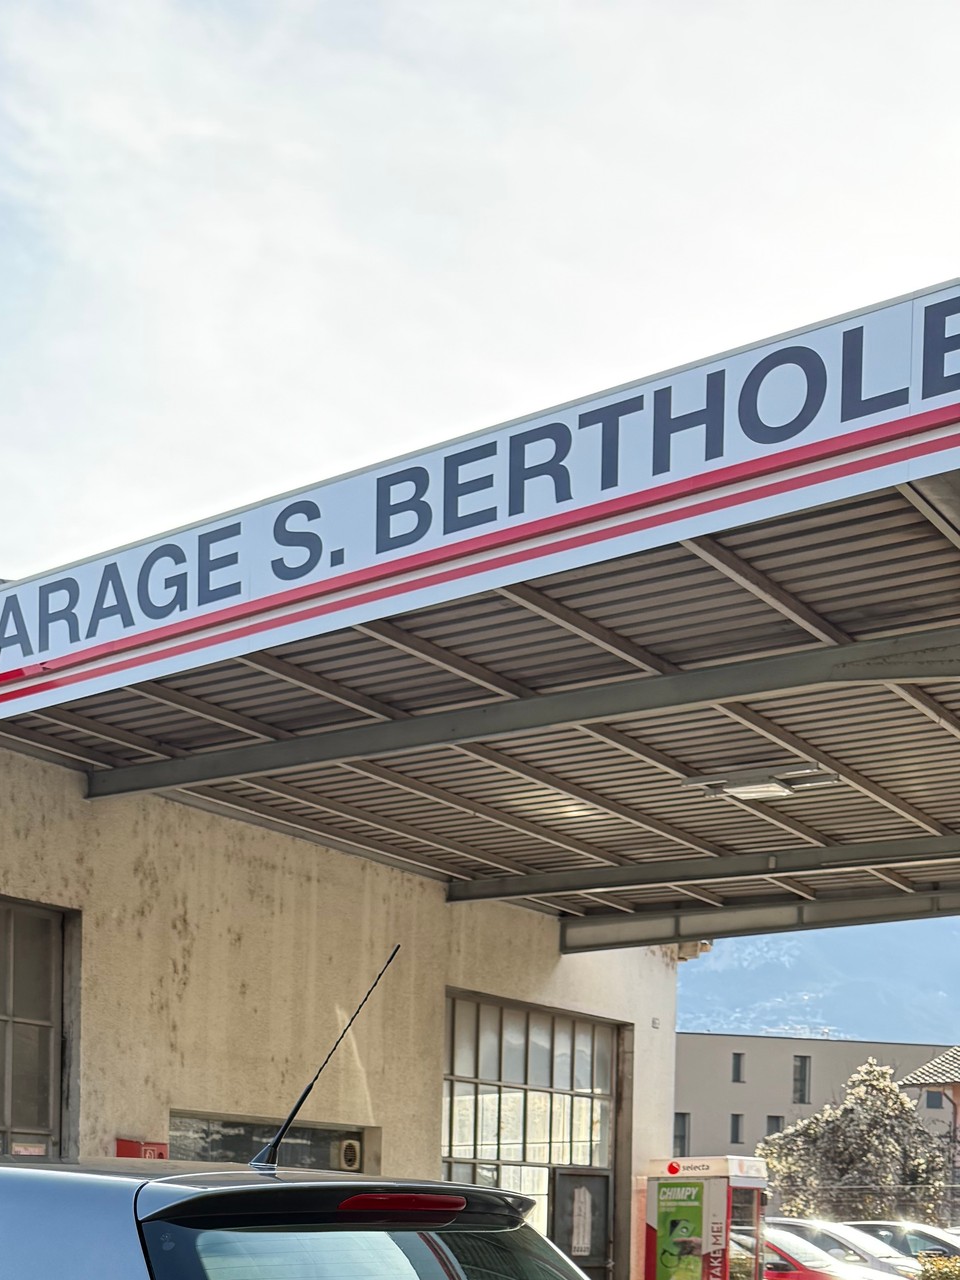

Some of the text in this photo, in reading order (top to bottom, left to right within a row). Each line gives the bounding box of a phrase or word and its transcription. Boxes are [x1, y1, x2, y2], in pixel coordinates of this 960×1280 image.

[271, 500, 345, 581] S.
[375, 296, 960, 555] BERTHOLE
[659, 1187, 698, 1200] CHIMPY
[711, 1222, 723, 1246] ME!
